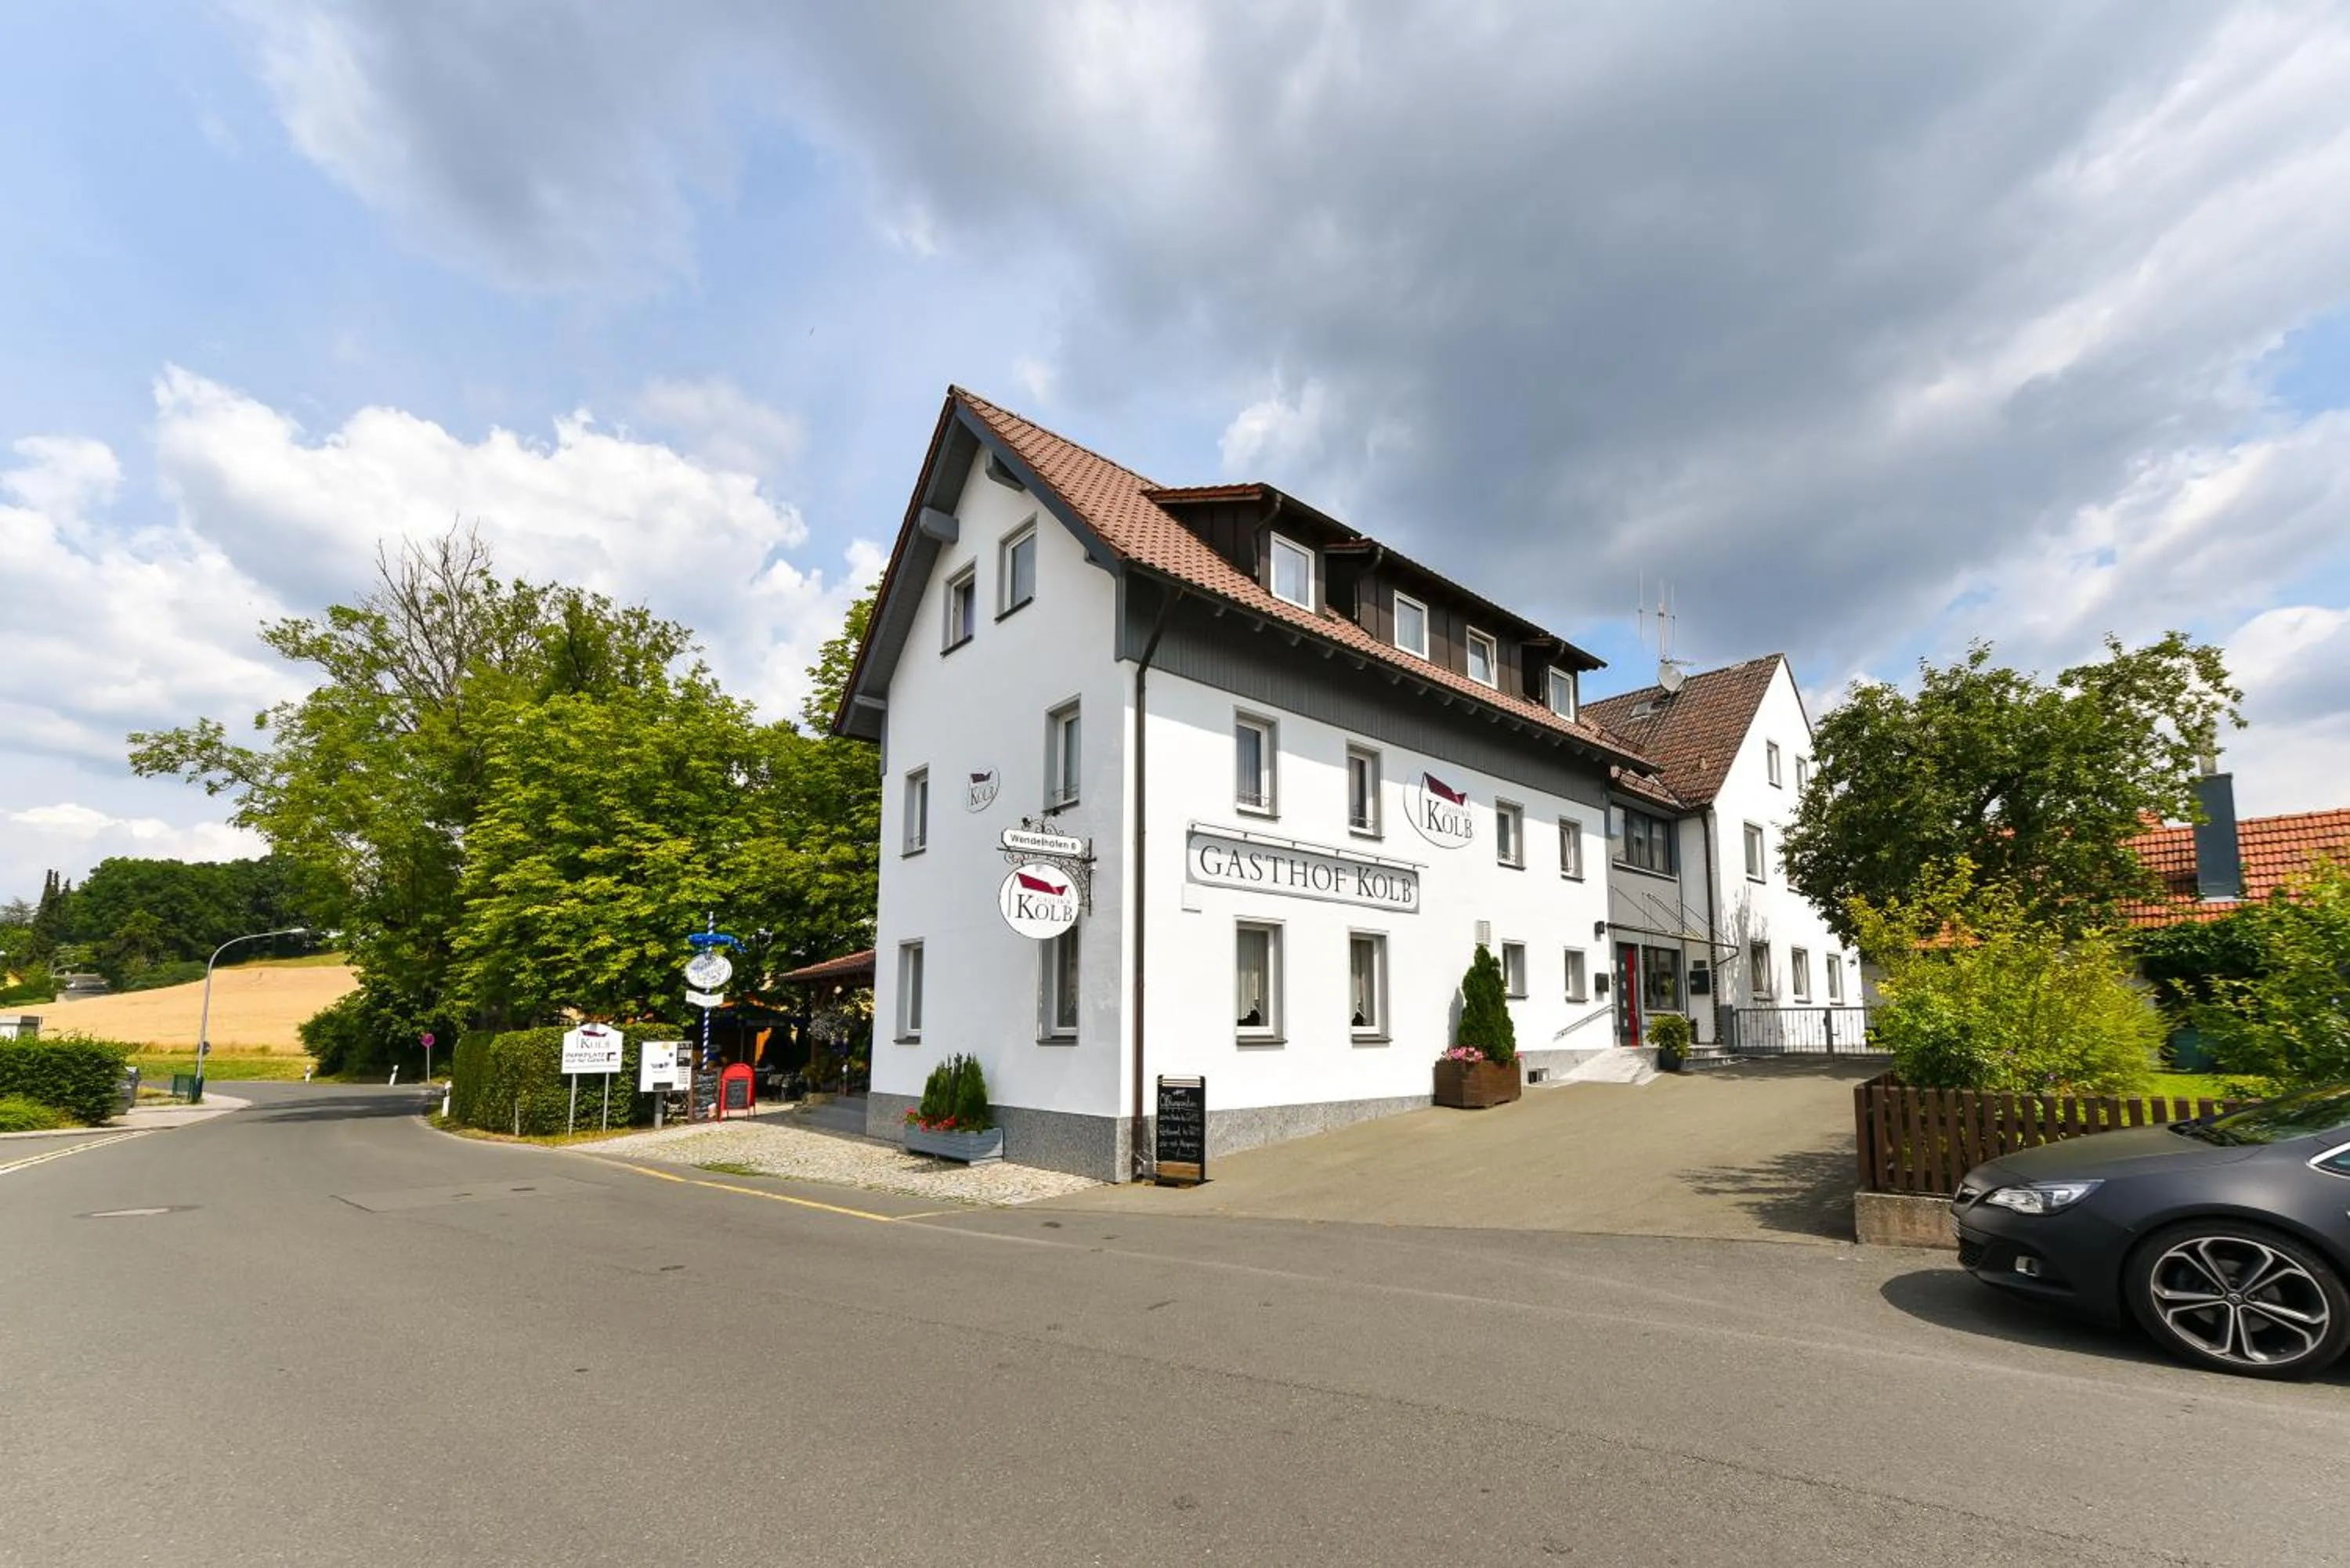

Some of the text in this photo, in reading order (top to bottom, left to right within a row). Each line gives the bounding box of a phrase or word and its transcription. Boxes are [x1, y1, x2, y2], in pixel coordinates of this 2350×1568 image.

[1426, 799, 1473, 839] KOLB
[1200, 845, 1412, 902] GASTHOF KOLB
[1015, 894, 1072, 922] KOLB
